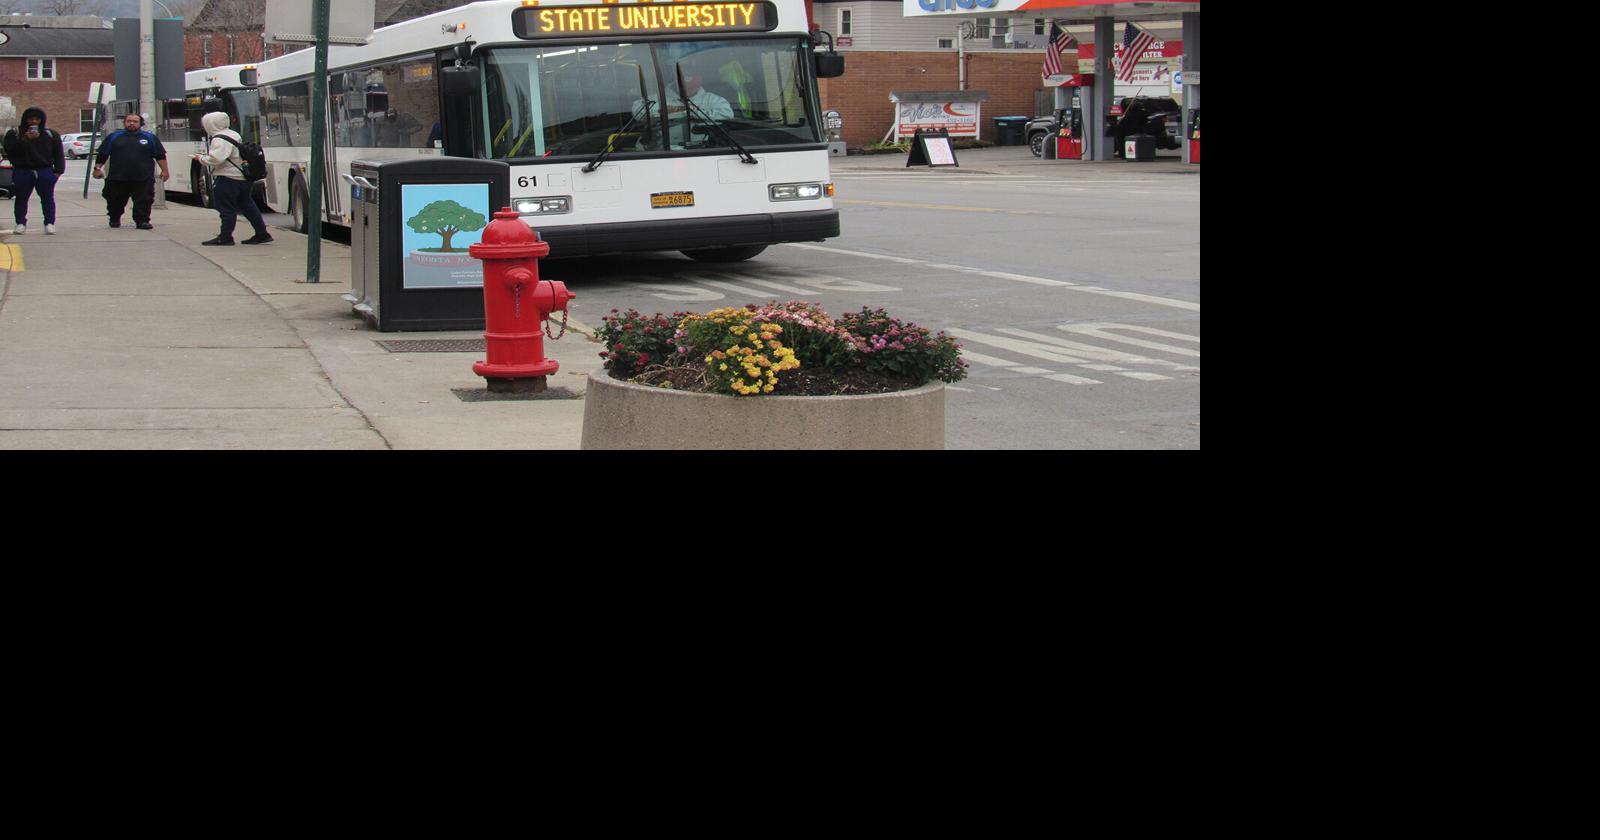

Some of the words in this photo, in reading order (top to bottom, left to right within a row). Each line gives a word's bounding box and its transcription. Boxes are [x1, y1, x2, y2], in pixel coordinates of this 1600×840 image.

[539, 8, 611, 32] STATE
[618, 3, 755, 30] UNIVERSITY
[517, 175, 537, 188] 61
